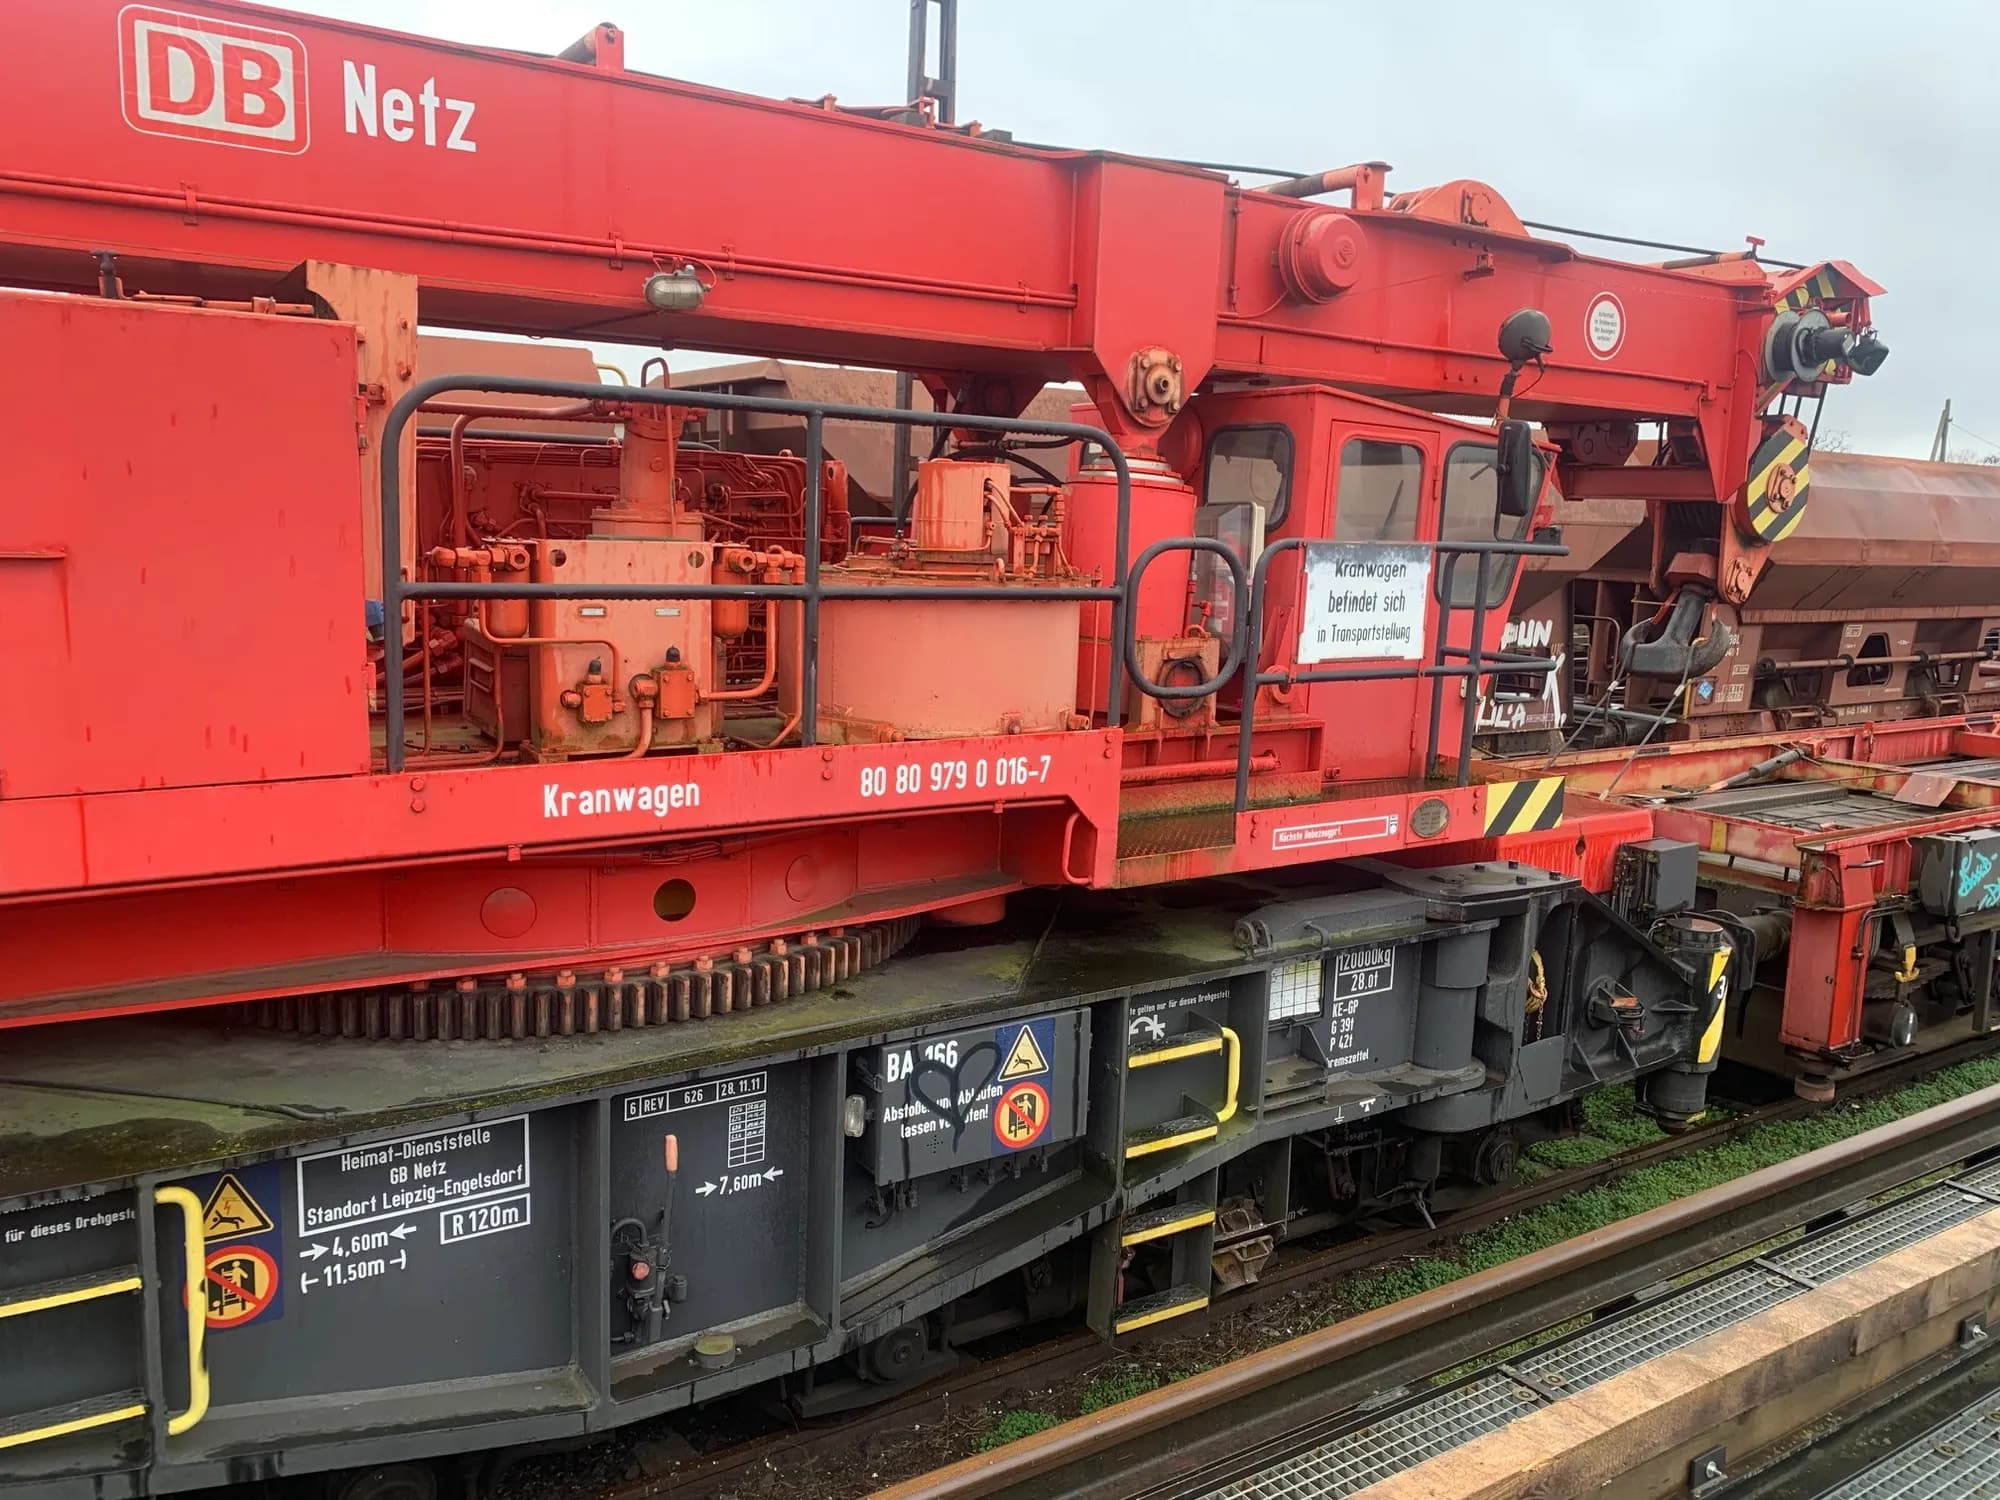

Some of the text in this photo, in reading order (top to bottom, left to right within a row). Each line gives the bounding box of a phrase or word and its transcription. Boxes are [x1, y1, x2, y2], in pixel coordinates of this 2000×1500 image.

[143, 26, 290, 131] DB
[343, 59, 477, 153] Netz
[1335, 558, 1407, 582] Kranwagen
[1328, 590, 1406, 613] befindet sich
[1317, 622, 1411, 646] in Transportstellung
[860, 755, 1052, 797] 80 80 979 0 016-7
[543, 782, 701, 818] Kranwagen
[1339, 948, 1391, 970] 120000kg
[1717, 975, 1726, 1000] 3
[1332, 1000, 1359, 1018] KE-GP
[1340, 1017, 1354, 1033] 39t
[1330, 1034, 1353, 1052] P 42t
[887, 1049, 914, 1083] BA
[629, 1102, 637, 1115] 6
[644, 1097, 664, 1113] REV
[684, 1089, 704, 1104] 626
[883, 1100, 932, 1124] Abstoße
[900, 1119, 936, 1139] lassen
[341, 1129, 491, 1172] Heimat-Dienststelle
[390, 1160, 447, 1185] GB Netz
[719, 1172, 762, 1195] 7,60m
[307, 1164, 524, 1226] Standort Leipzig-Engelsdorf
[5, 1229, 25, 1243] für
[30, 1222, 72, 1238] dieses
[452, 1205, 519, 1236] R 120m
[332, 1230, 389, 1258] 4,60m
[323, 1258, 385, 1287] 11,50m
